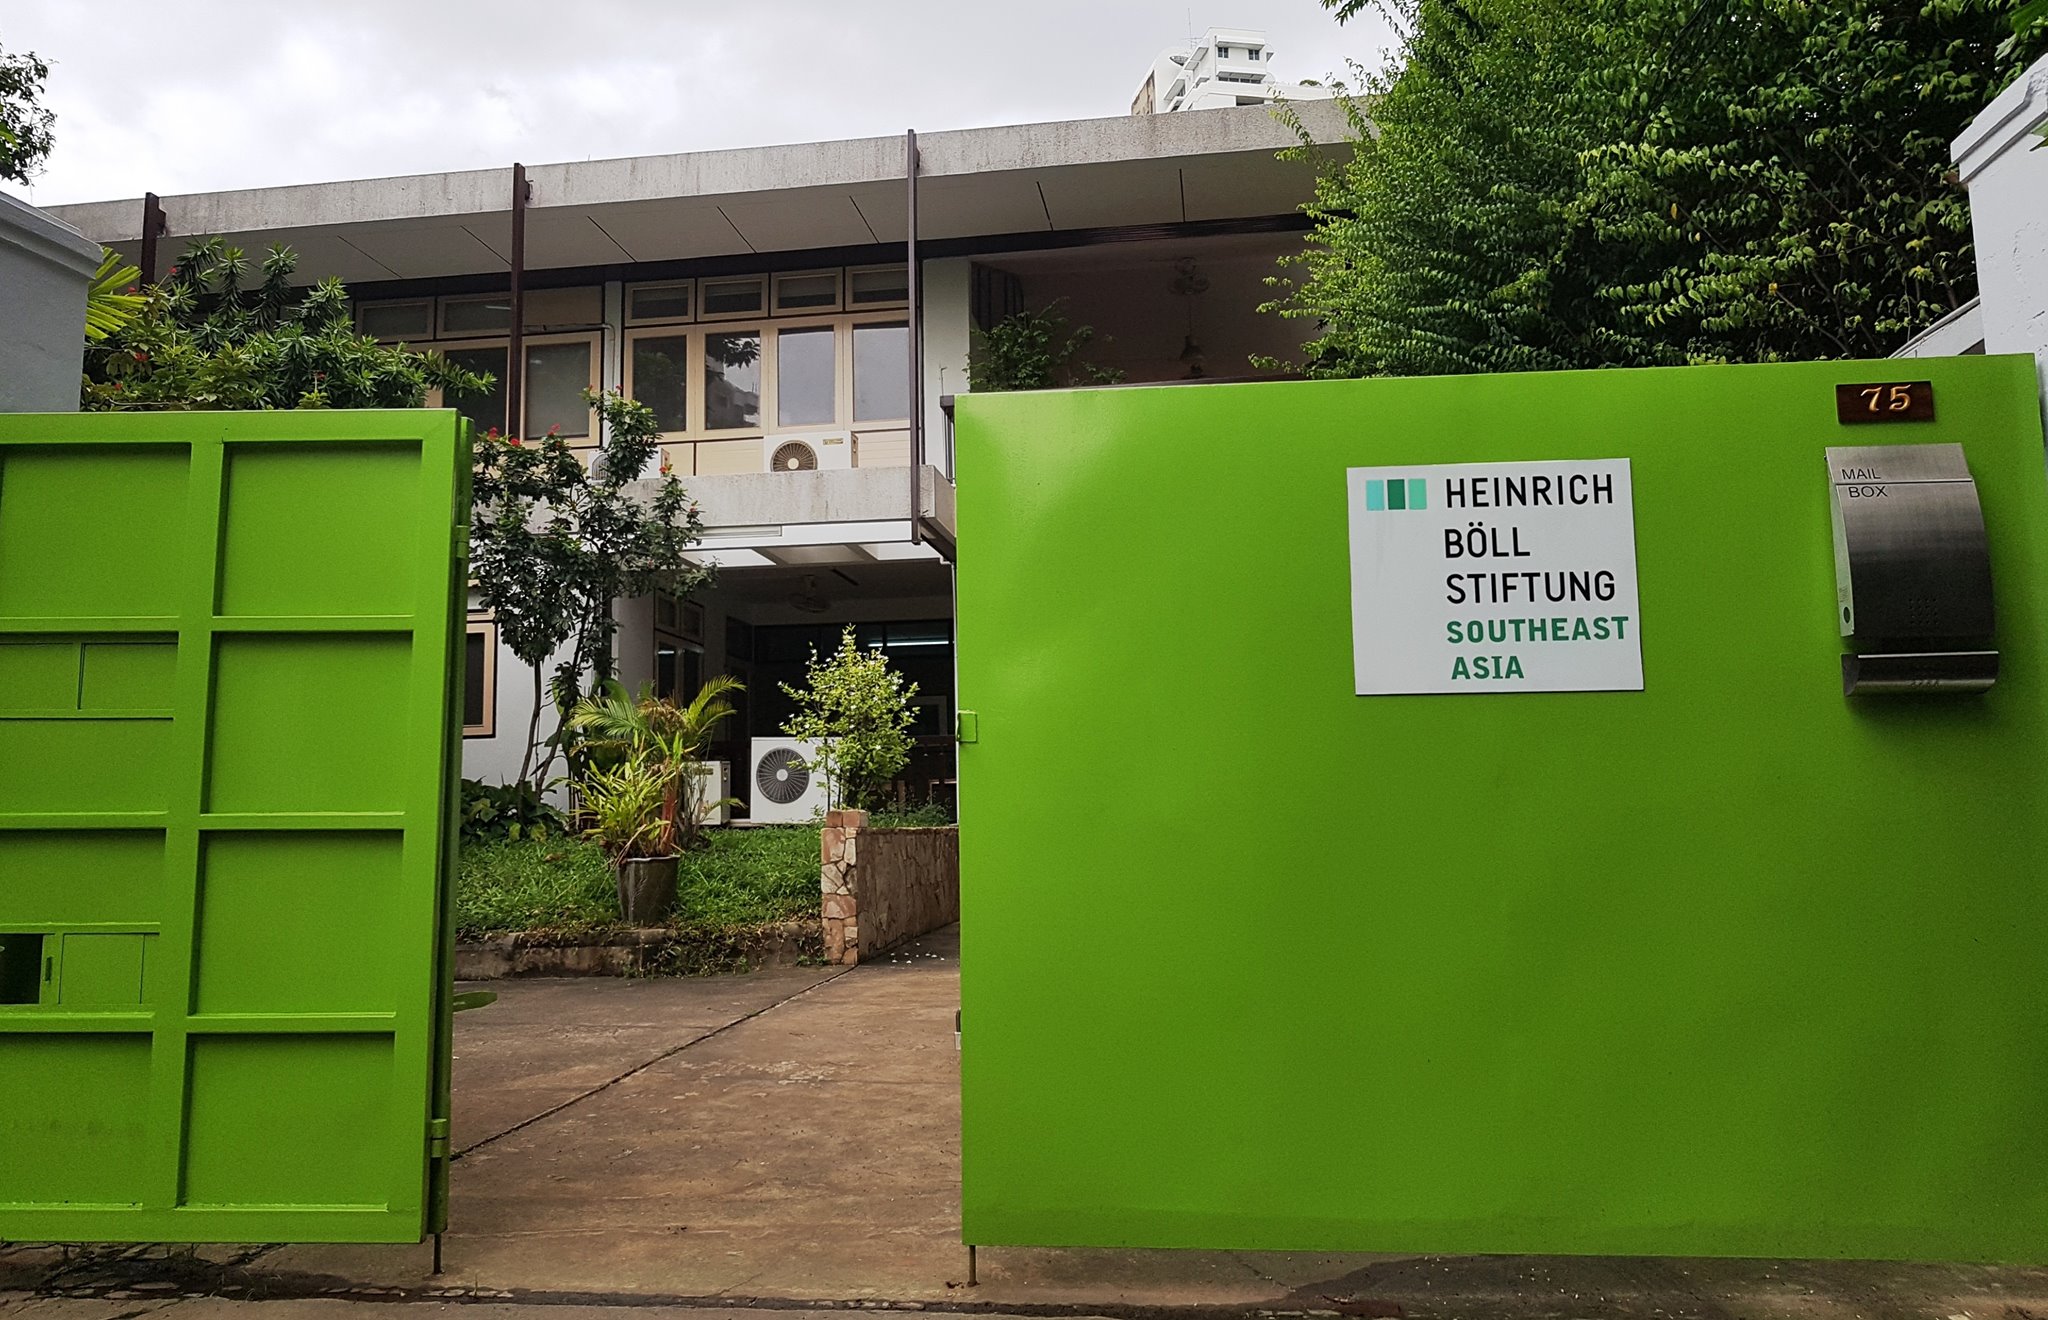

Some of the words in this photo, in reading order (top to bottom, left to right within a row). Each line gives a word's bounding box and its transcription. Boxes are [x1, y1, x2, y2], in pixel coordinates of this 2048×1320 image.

[1860, 384, 1911, 412] 75
[1841, 468, 1881, 480] MAIL
[1445, 473, 1613, 509] HEINRICH
[1848, 485, 1888, 498] BOX
[1444, 521, 1531, 559] BÖLL
[1446, 570, 1616, 605] STIFTUNG
[1446, 615, 1629, 644] SOUTHEAST
[1451, 655, 1525, 680] ASIA
